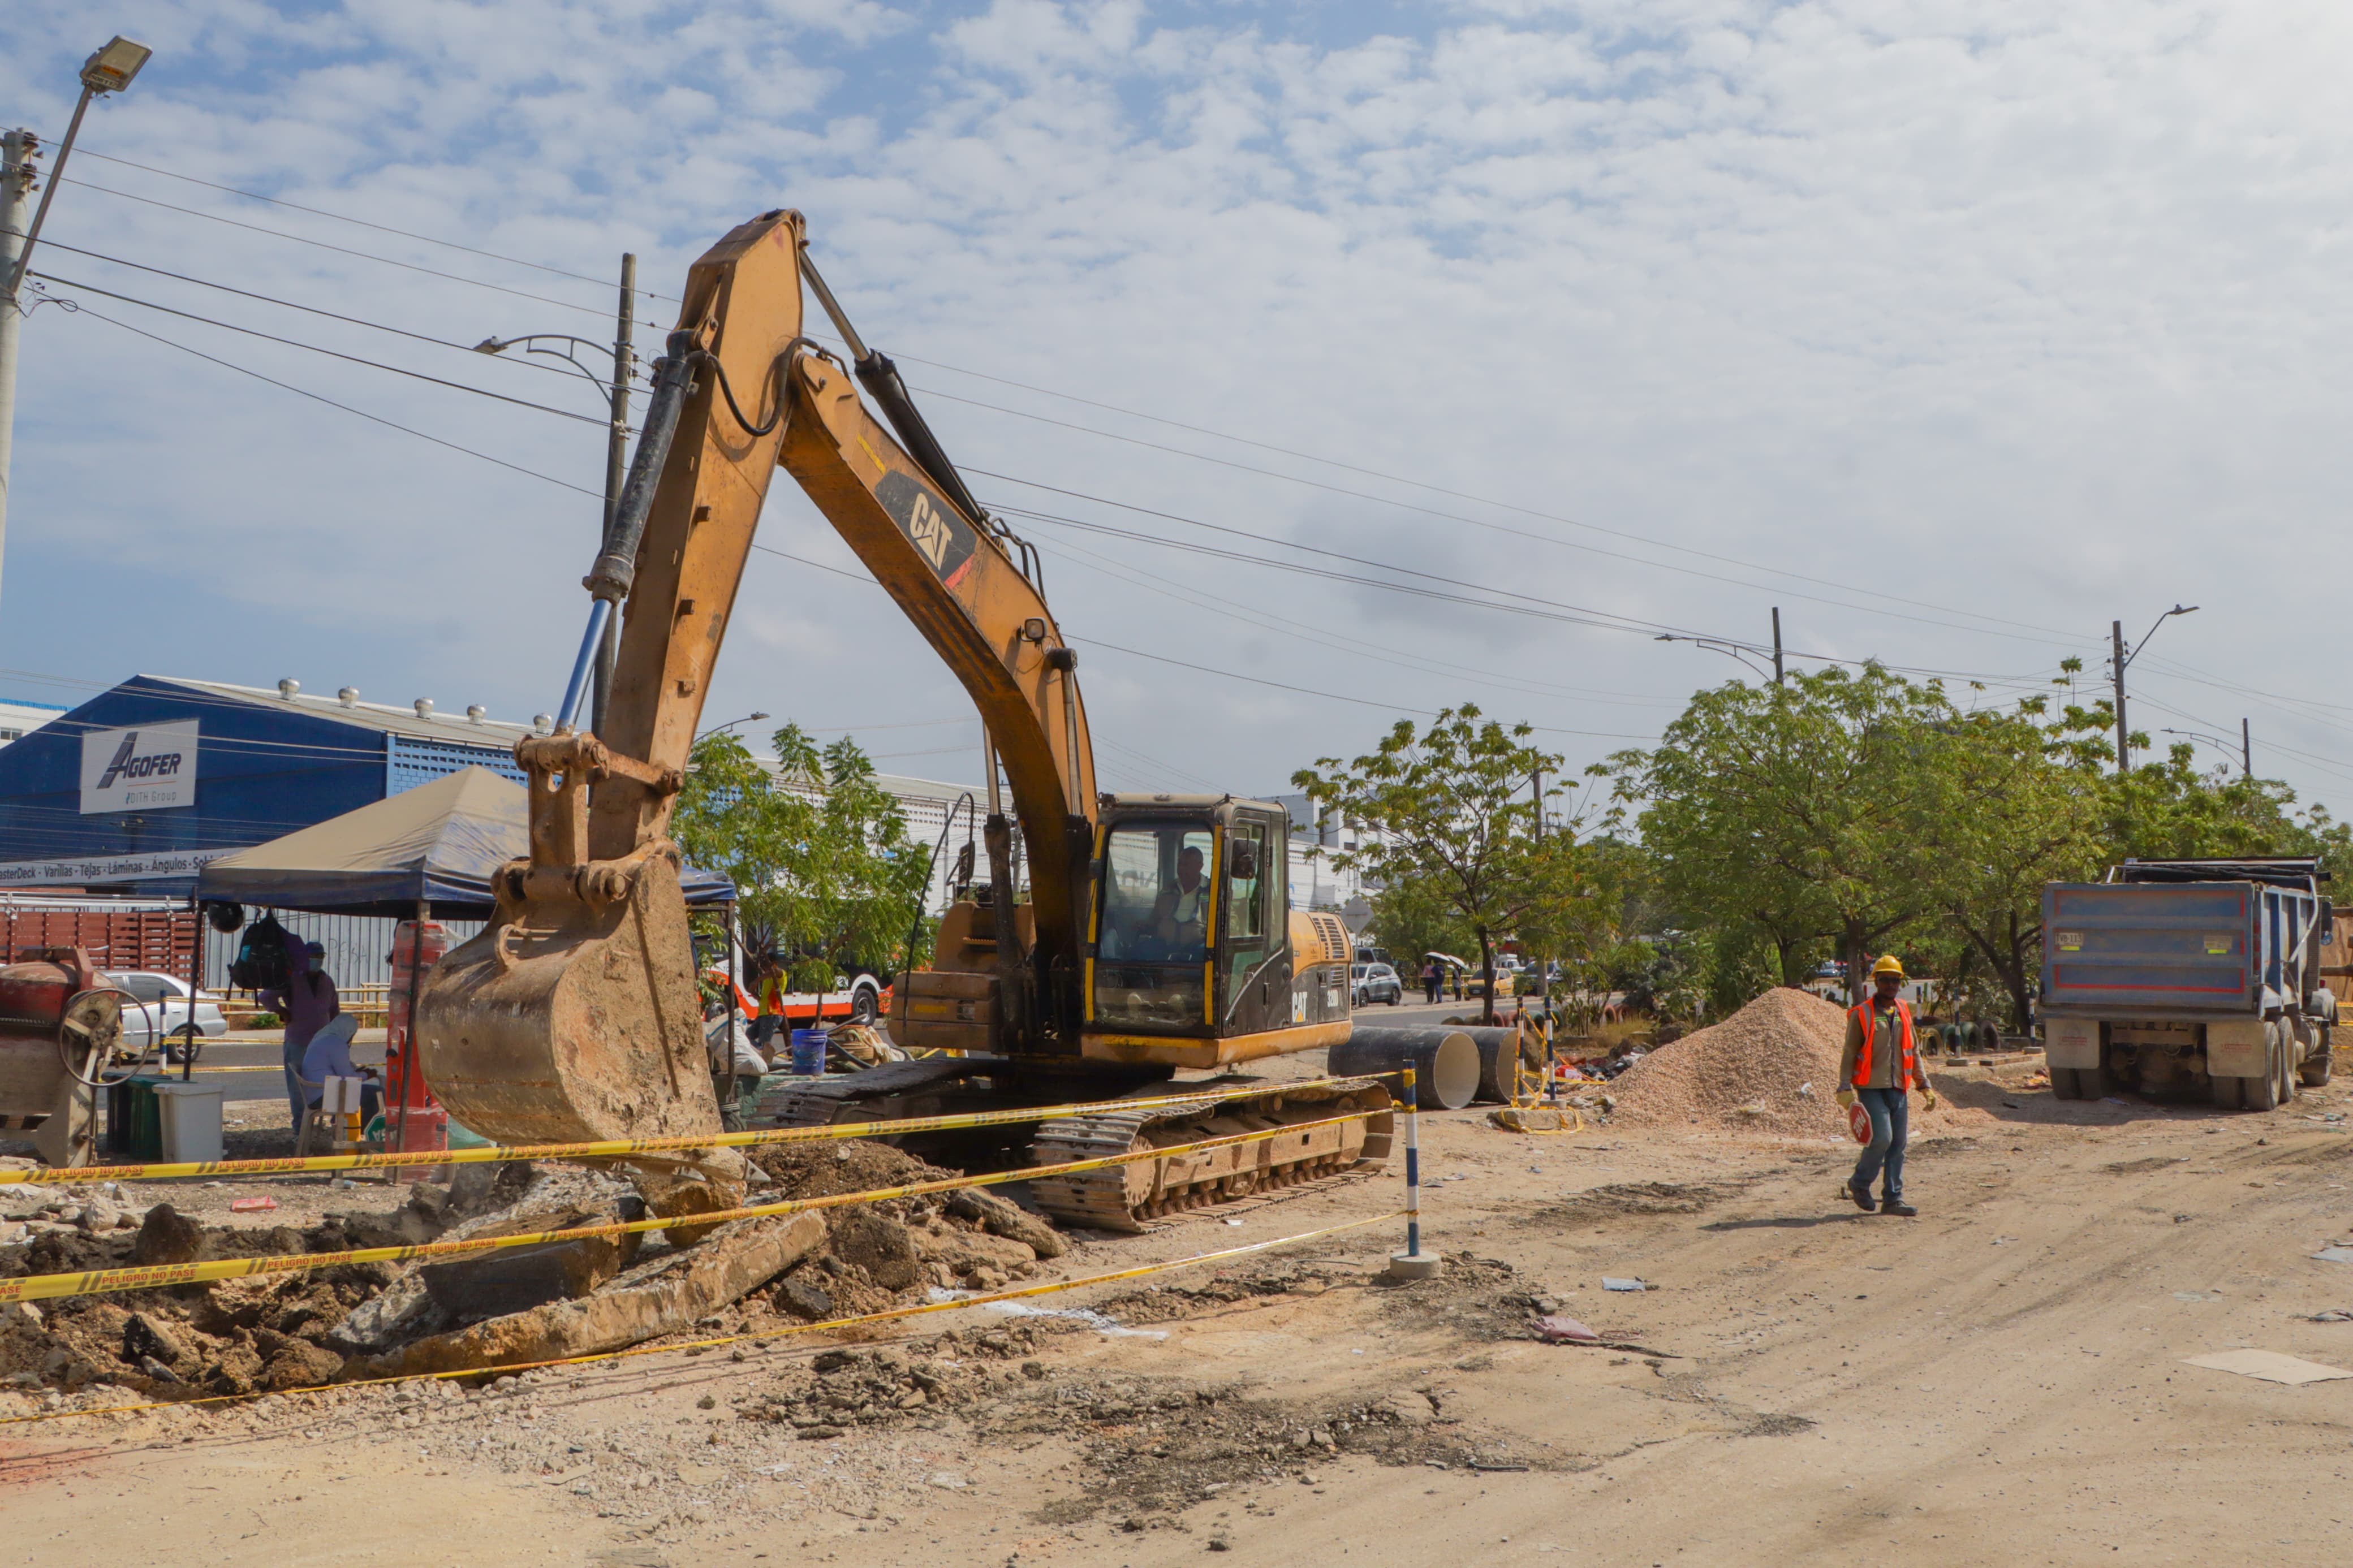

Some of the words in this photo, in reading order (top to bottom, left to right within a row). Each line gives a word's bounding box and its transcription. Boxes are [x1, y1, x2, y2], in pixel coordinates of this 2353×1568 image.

[910, 493, 953, 571] CAT
[97, 732, 182, 789] AGOFER
[152, 791, 177, 804] Group
[45, 863, 73, 877] Varillas
[79, 862, 101, 879] Tejas
[109, 859, 143, 874] Láminas
[152, 855, 187, 874] Ángulos
[1292, 991, 1308, 1023] CAT
[49, 1168, 96, 1176] PELIGRO
[418, 1243, 456, 1253] PELIGRO
[268, 1258, 309, 1268] PELIGRO
[329, 1254, 352, 1263] PASE
[102, 1273, 148, 1284] PELIGRO
[170, 1269, 196, 1278] PASE
